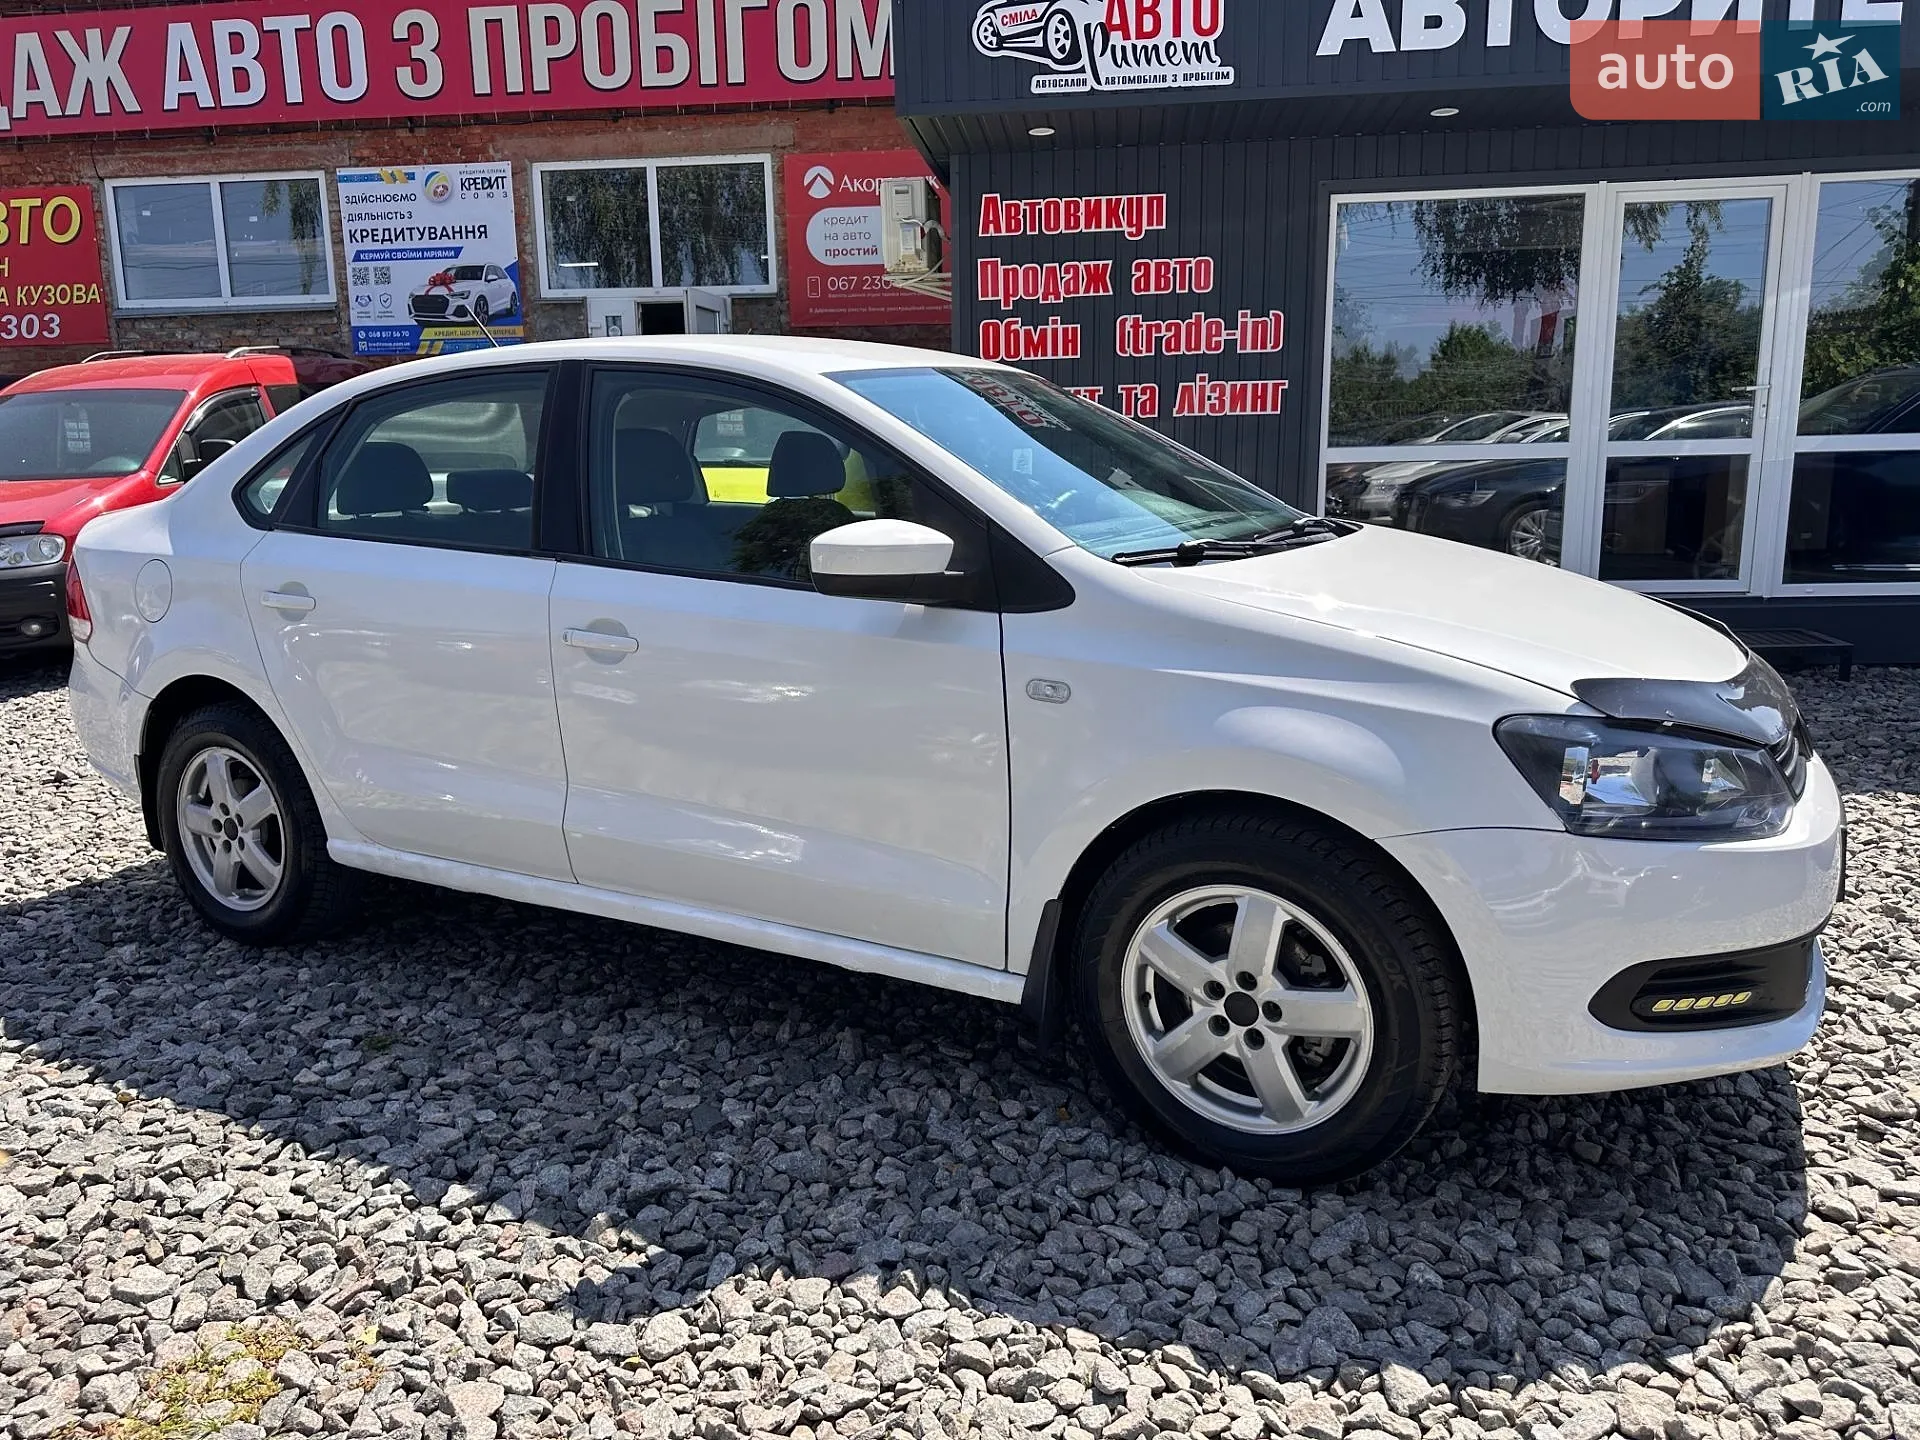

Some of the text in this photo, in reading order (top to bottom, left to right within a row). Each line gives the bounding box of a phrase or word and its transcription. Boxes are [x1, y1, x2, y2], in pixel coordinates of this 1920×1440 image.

[1001, 8, 1038, 26] СМІЛА
[1105, 0, 1220, 41] АВТО
[0, 0, 895, 130] АЖ АВТО З ПРОБІГОМ
[1035, 77, 1088, 89] АВТОСАЛОН
[1104, 74, 1168, 86] АВТОМОБІЛІВ
[1182, 71, 1230, 82] ПРОБІГОМ
[344, 192, 417, 205] ЗДІЙСНЮЄМО
[346, 211, 405, 223] ДІЯЛЬНІСТЬ
[823, 215, 869, 227] кредит
[978, 193, 1167, 240] Автовикуп
[348, 224, 488, 245] КРЕДИТУВАННЯ
[824, 231, 872, 241] на авто
[360, 249, 455, 260] КЕРМУЙ СВОЇМИ МРІЯМИ
[824, 244, 878, 258] простий
[827, 276, 857, 291] 067
[977, 256, 1214, 309] Продаж авто
[16, 283, 101, 306] КУЗОВА
[0, 313, 61, 339] 303
[979, 309, 1285, 361] Обмін (trade-in)
[1117, 382, 1159, 419] та
[1173, 373, 1288, 417] лізинг
